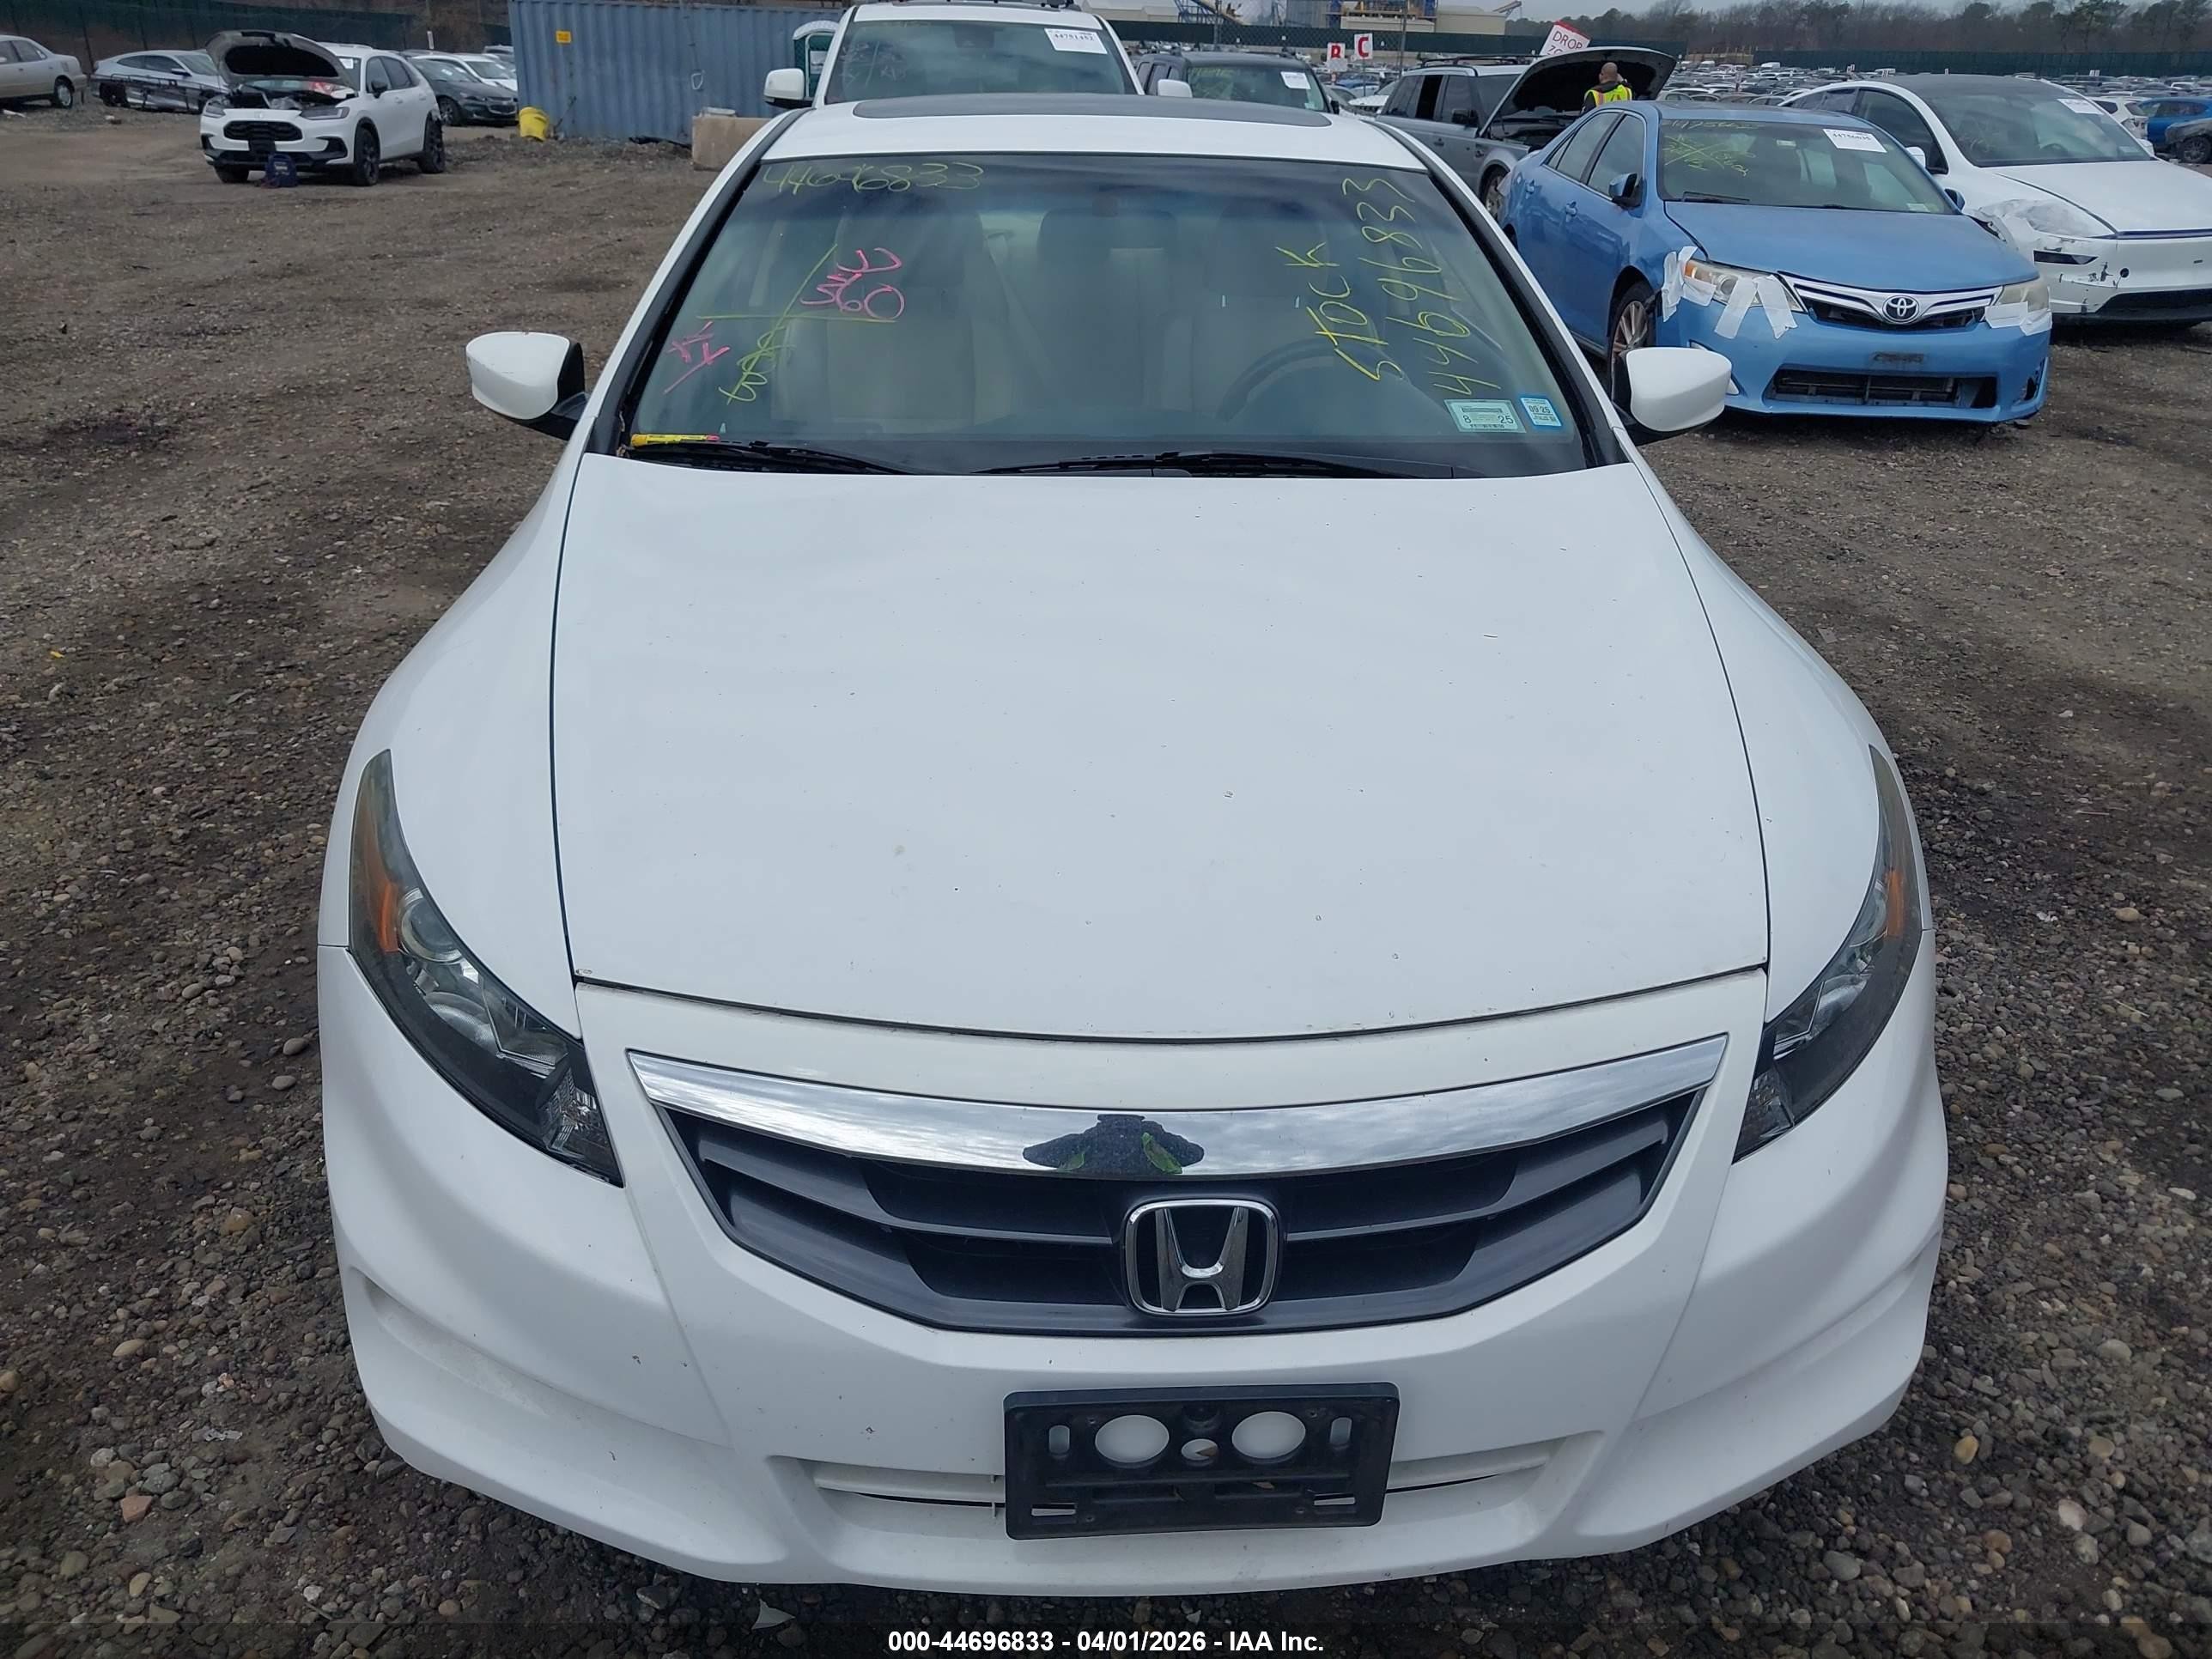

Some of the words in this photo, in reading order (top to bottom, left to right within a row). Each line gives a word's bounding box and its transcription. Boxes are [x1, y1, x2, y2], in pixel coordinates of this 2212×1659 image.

[1358, 37, 1369, 58] C
[1553, 31, 1583, 49] DROP
[1342, 178, 1501, 395] 44696833
[1275, 242, 1404, 380] STOCK
[1462, 415, 1472, 423] 8
[1498, 415, 1514, 424] 25
